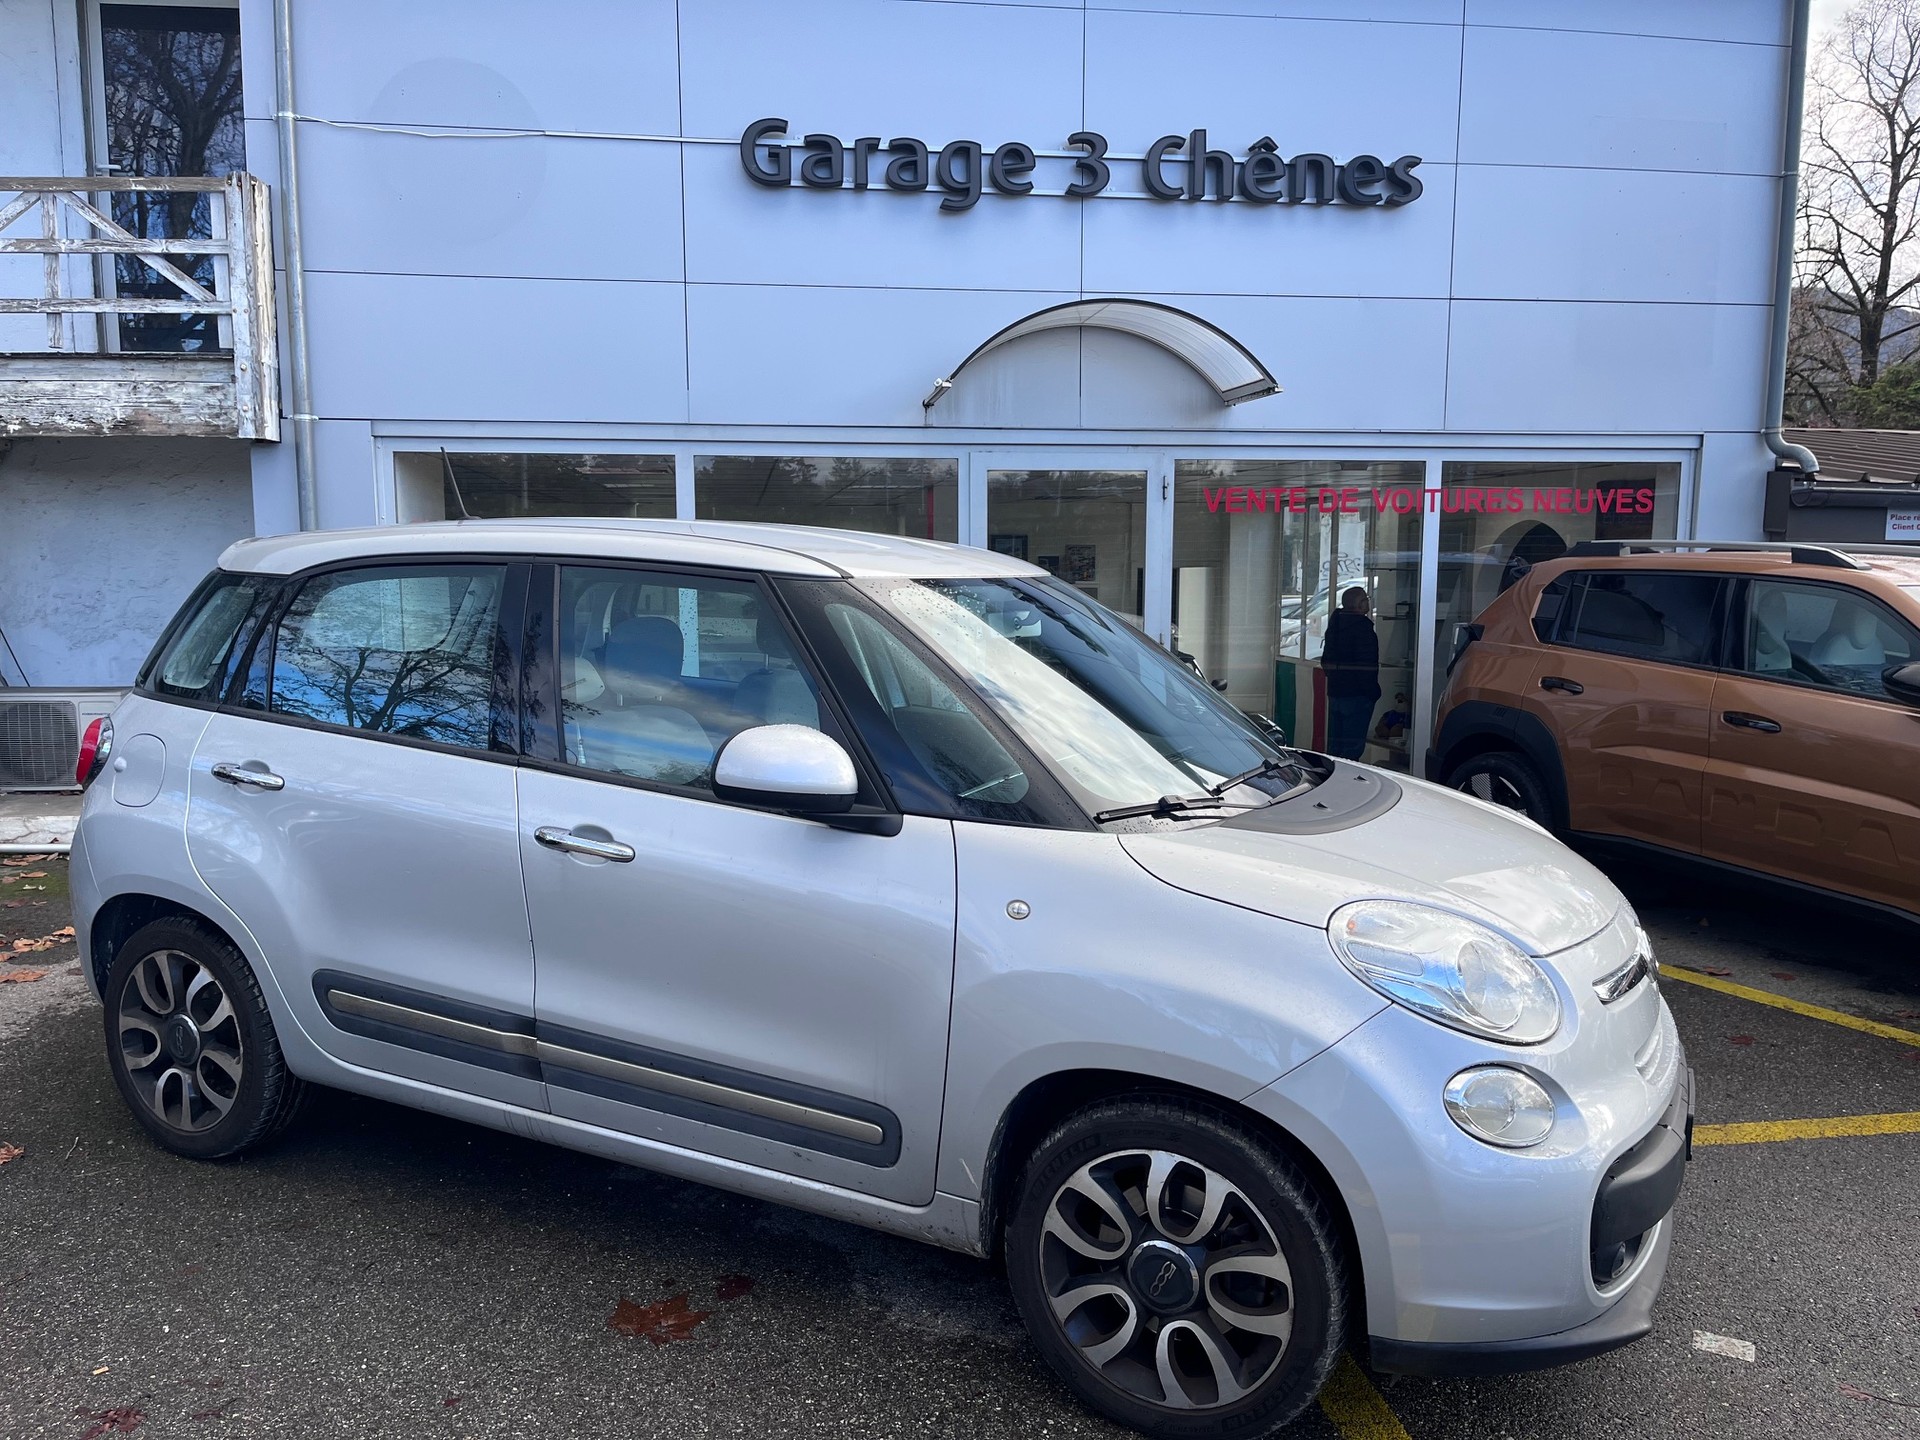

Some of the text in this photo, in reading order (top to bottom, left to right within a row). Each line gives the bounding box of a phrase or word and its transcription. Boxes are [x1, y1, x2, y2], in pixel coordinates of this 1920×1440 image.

[740, 118, 1424, 211] Garage 3 Chênes
[1203, 487, 1654, 514] VENTE DE VOITURES NEUVES
[1890, 513, 1912, 521] Place
